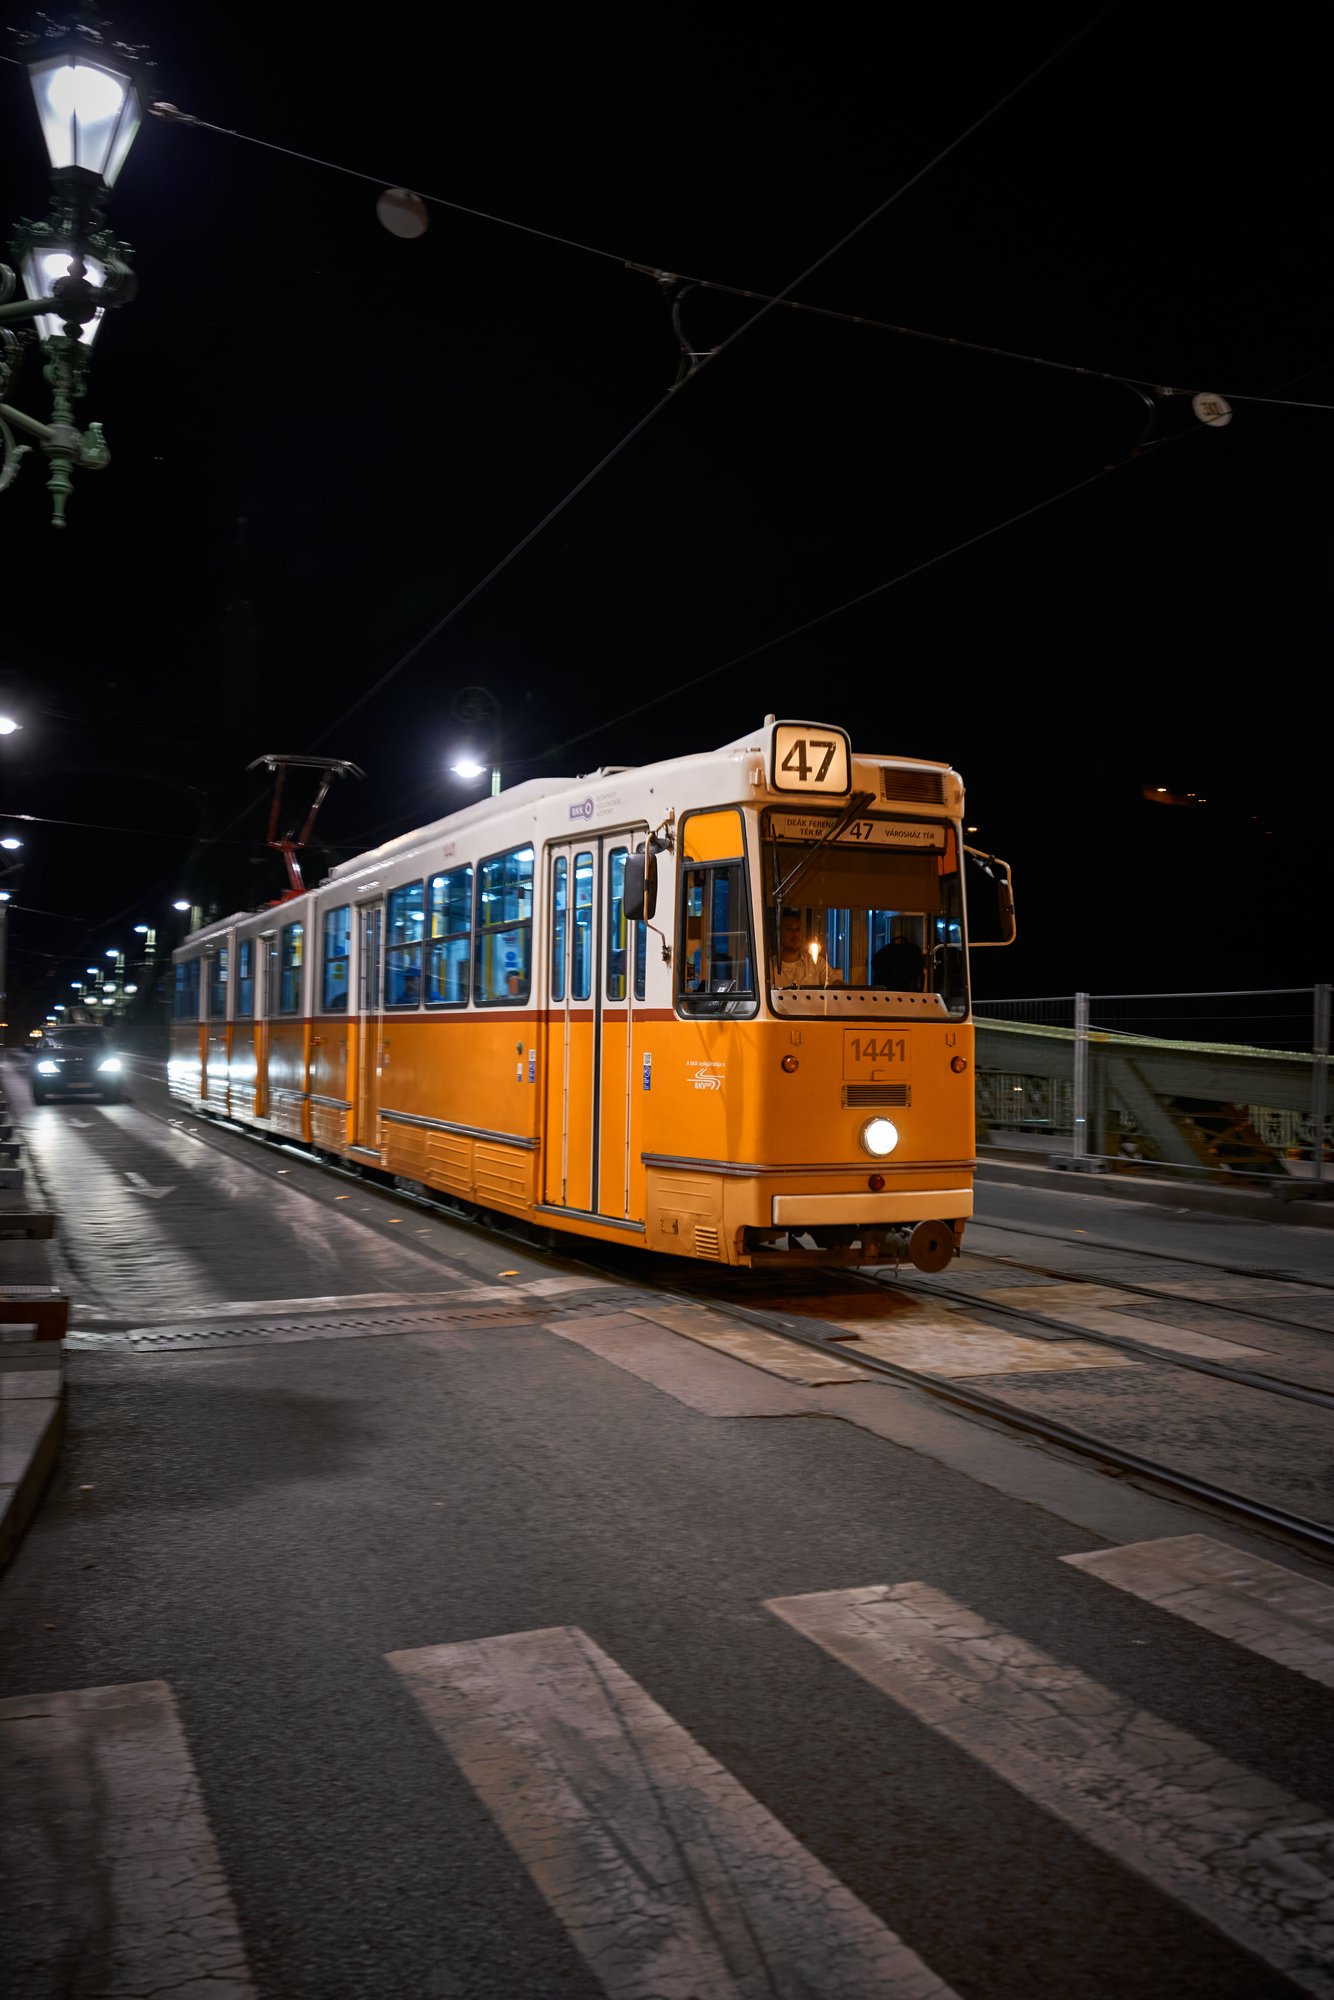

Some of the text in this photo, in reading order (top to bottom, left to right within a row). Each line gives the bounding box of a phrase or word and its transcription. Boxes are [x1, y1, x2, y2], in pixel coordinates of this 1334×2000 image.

[781, 739, 837, 782] 47
[787, 818, 806, 827] DEÁK
[800, 828, 813, 836] TÉR
[849, 822, 874, 840] 47
[885, 828, 935, 840] VÁROSHÁZ TÉR
[850, 1038, 905, 1062] 1441
